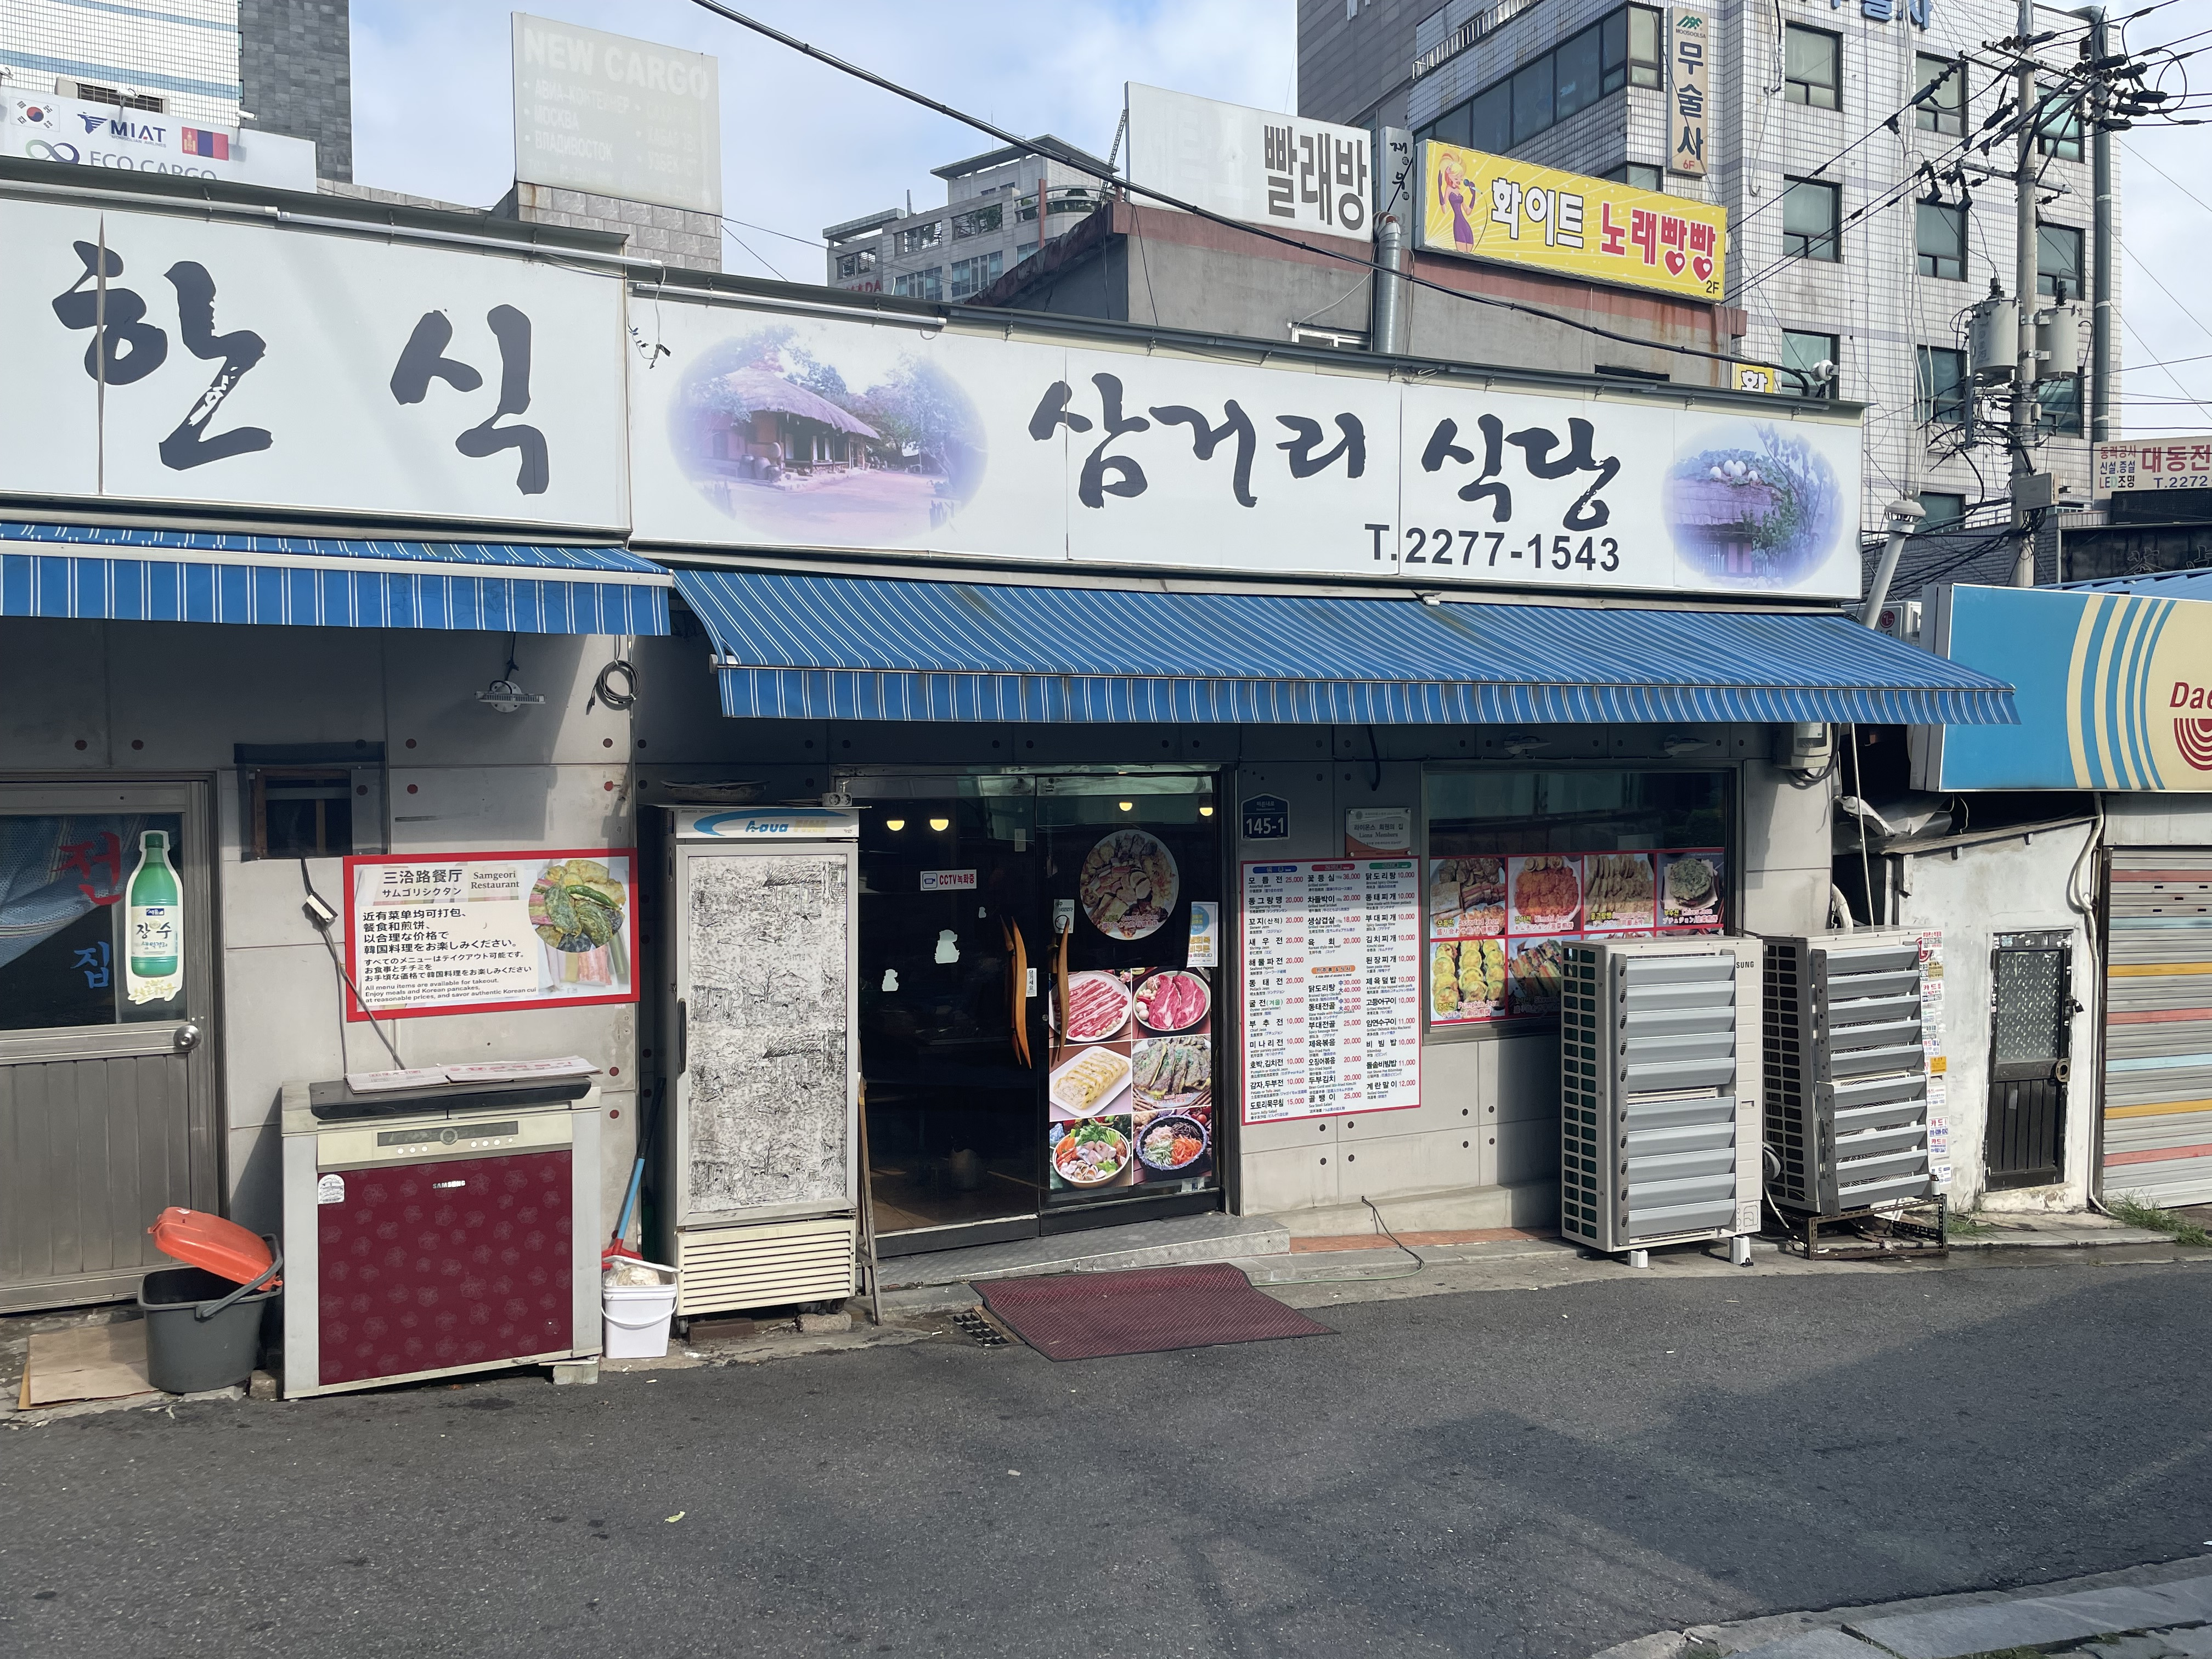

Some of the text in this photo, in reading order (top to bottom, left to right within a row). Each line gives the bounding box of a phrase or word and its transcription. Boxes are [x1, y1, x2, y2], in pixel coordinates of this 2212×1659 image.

[1675, 28, 1706, 39] MOOSOOLSA
[1677, 41, 1703, 160] 무술사
[111, 119, 166, 143] MIAT
[1683, 160, 1695, 170] 6F
[1264, 125, 1367, 231] 빨래방
[1491, 177, 1584, 249] 화이트
[1705, 280, 1720, 295] 2F
[1028, 373, 1621, 532] 삼거리 식당
[2101, 445, 2137, 460] 동력공사
[2099, 475, 2135, 489] LED조명
[2153, 476, 2212, 489] T.2272
[1364, 523, 1621, 572] T.2277-1543
[1246, 817, 1284, 834] 145-1
[473, 871, 516, 881] Samgeori
[939, 874, 974, 885] CCTV녹화중
[471, 881, 520, 889] Restaurant
[382, 887, 462, 898] サムゴリシクタン
[1458, 1001, 1484, 1009] Pumpkin
[432, 1180, 466, 1189] SAMSUNG
